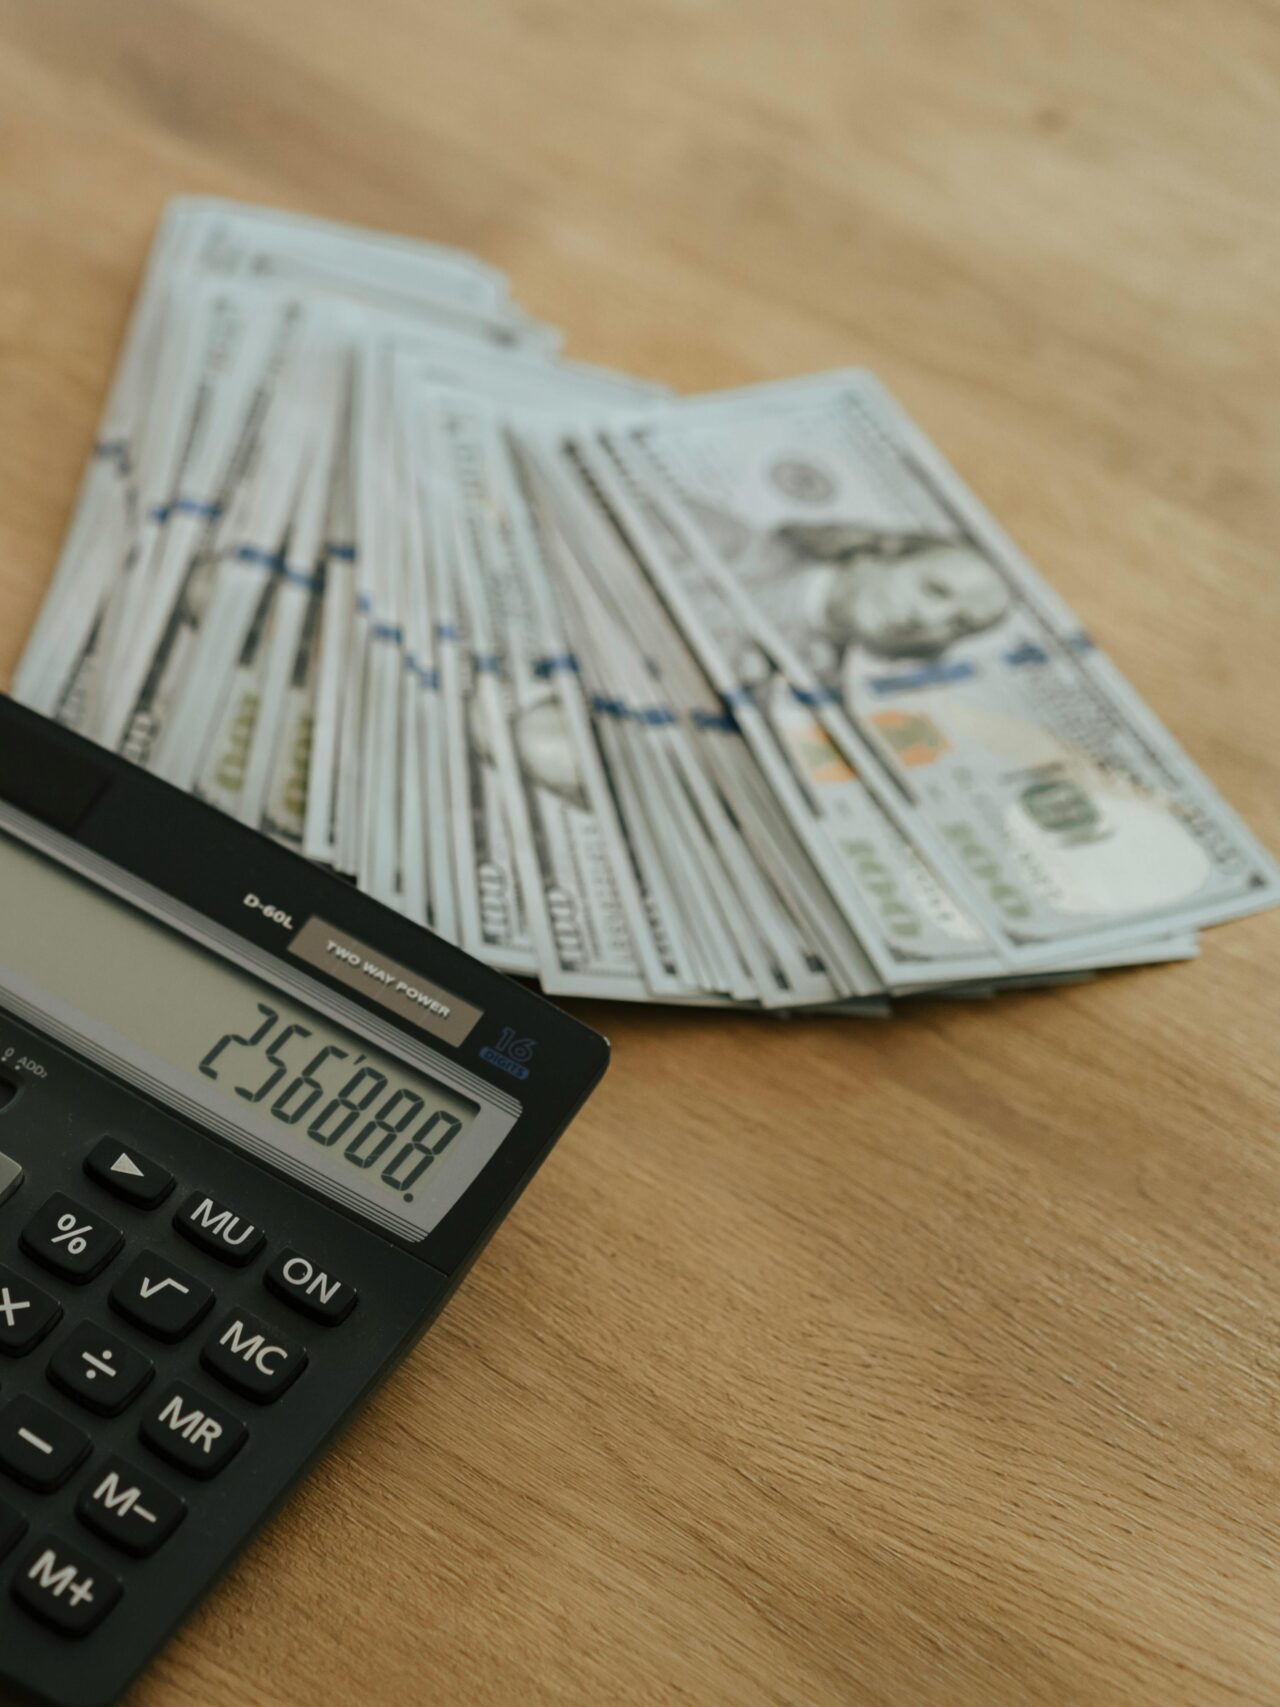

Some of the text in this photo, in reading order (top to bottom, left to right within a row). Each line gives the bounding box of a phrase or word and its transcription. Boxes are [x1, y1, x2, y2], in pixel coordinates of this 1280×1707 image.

[243, 893, 294, 930] D-60L
[325, 939, 451, 1018] TWO WAY POWER
[494, 1026, 538, 1062] 16
[190, 1198, 255, 1246] MU
[282, 1256, 342, 1305] ON
[219, 1320, 289, 1376] MC
[157, 1395, 223, 1454] MR
[92, 1471, 157, 1523] M-
[28, 1549, 95, 1607] M+
